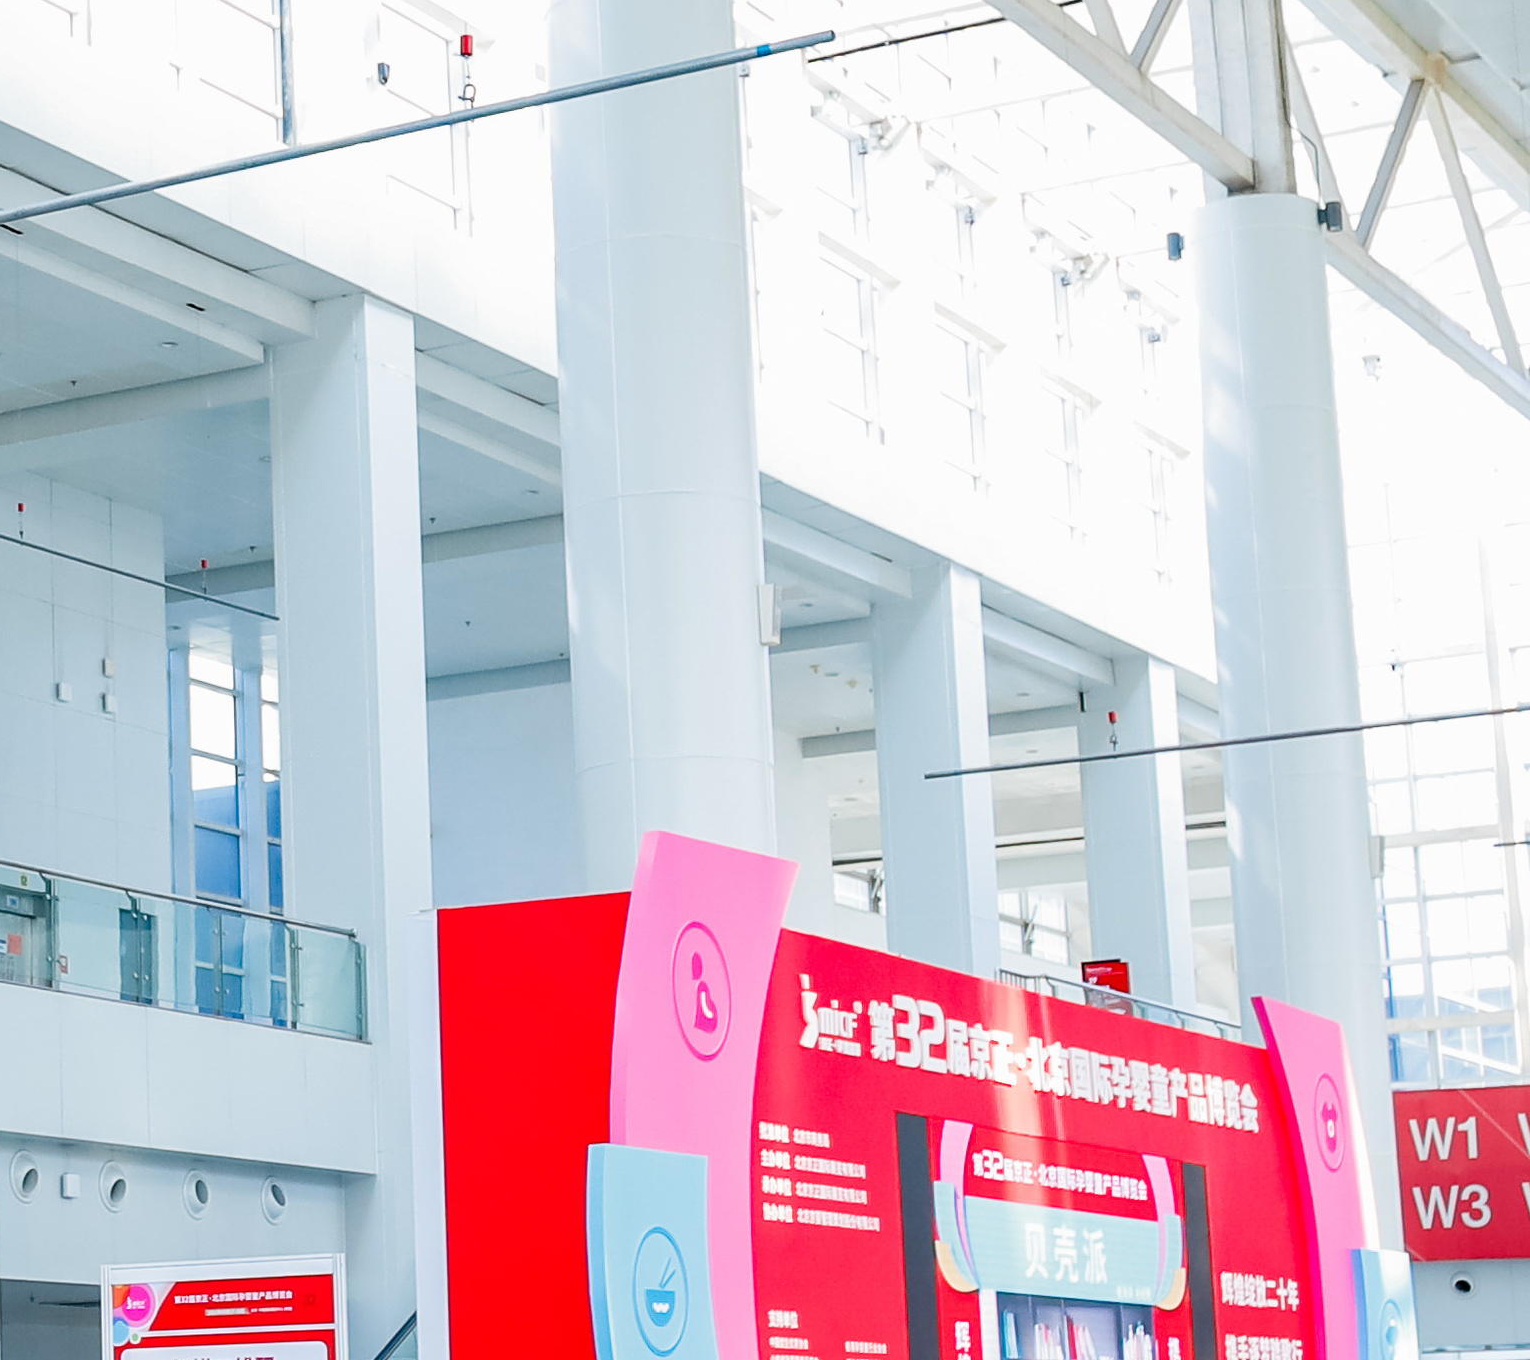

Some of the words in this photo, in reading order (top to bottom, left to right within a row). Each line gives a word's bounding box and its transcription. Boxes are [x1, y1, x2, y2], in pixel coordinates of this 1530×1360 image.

[869, 994, 1260, 1134] 第32届京正·北京国际孕婴童产品博览会
[1408, 1116, 1479, 1163] W1
[972, 1148, 1148, 1201] 第32届京正·北京国际孕婴童产品博览会
[1412, 1184, 1492, 1230] W3
[1024, 1222, 1108, 1284] 贝壳派
[1220, 1270, 1300, 1312] 辉煌绽放二十年
